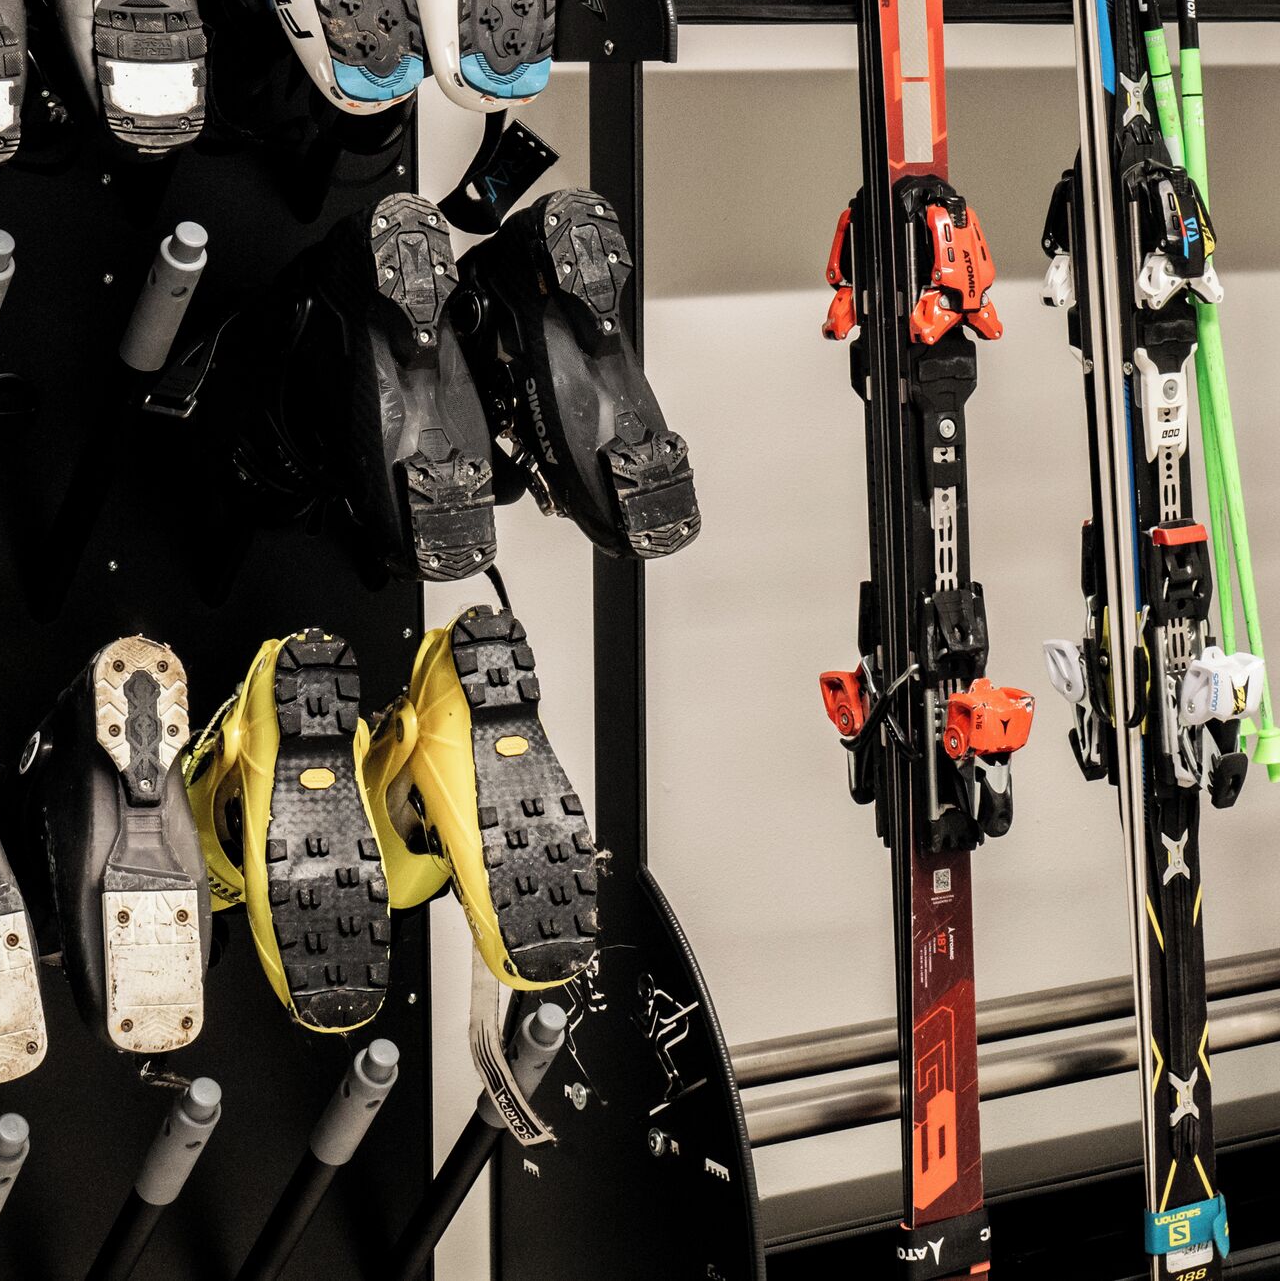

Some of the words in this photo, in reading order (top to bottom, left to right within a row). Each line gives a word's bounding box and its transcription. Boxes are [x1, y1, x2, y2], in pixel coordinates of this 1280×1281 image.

[962, 249, 976, 299] ATOMIC
[526, 377, 560, 467] ATOMIC
[937, 931, 947, 954] 187
[498, 1093, 536, 1139] SCARPA
[897, 1246, 928, 1261] ATO
